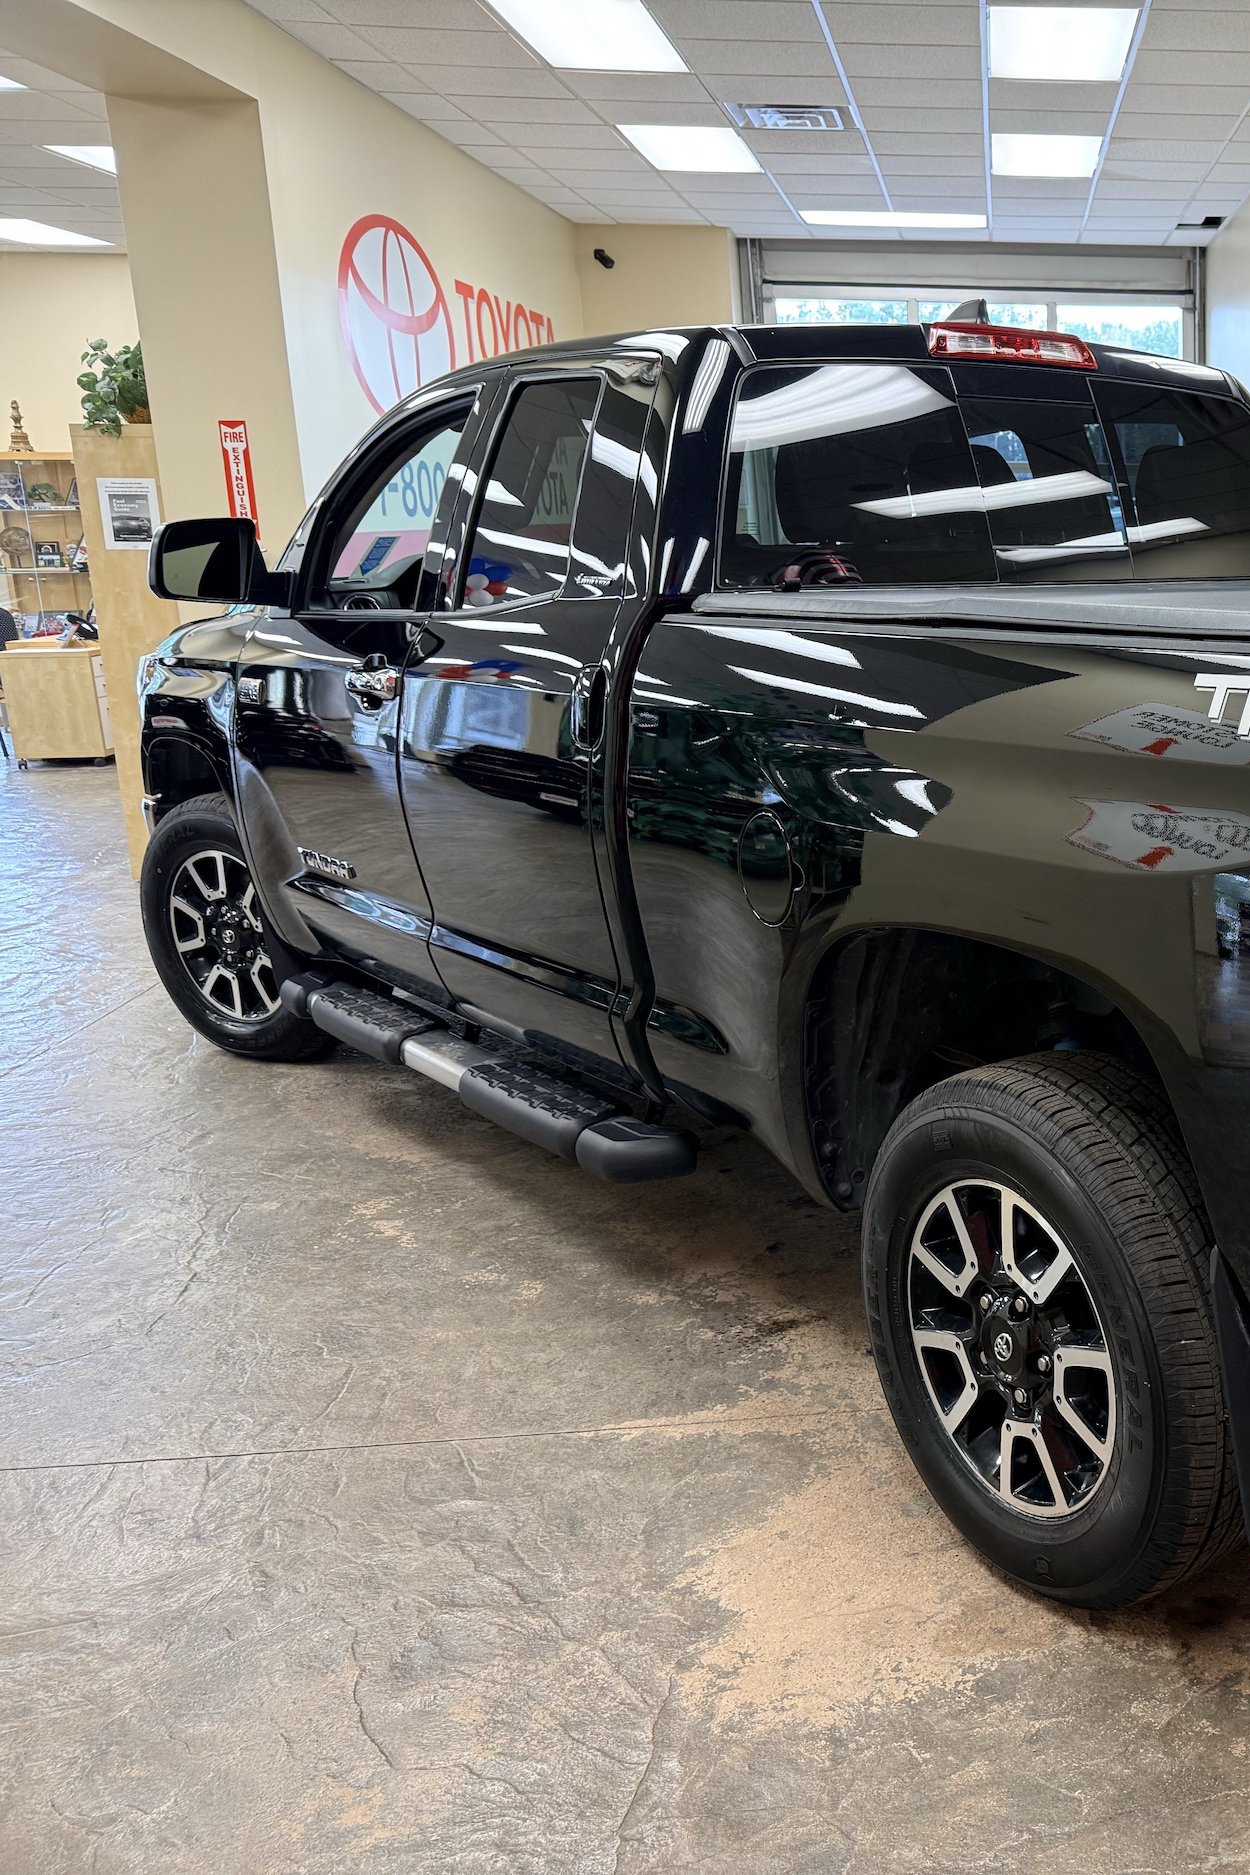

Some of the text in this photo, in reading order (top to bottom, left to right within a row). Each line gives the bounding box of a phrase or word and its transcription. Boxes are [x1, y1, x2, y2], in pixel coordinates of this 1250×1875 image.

[223, 432, 244, 443] FIRE
[232, 447, 248, 517] EXTINGUISH
[297, 846, 357, 880] TUNDRA
